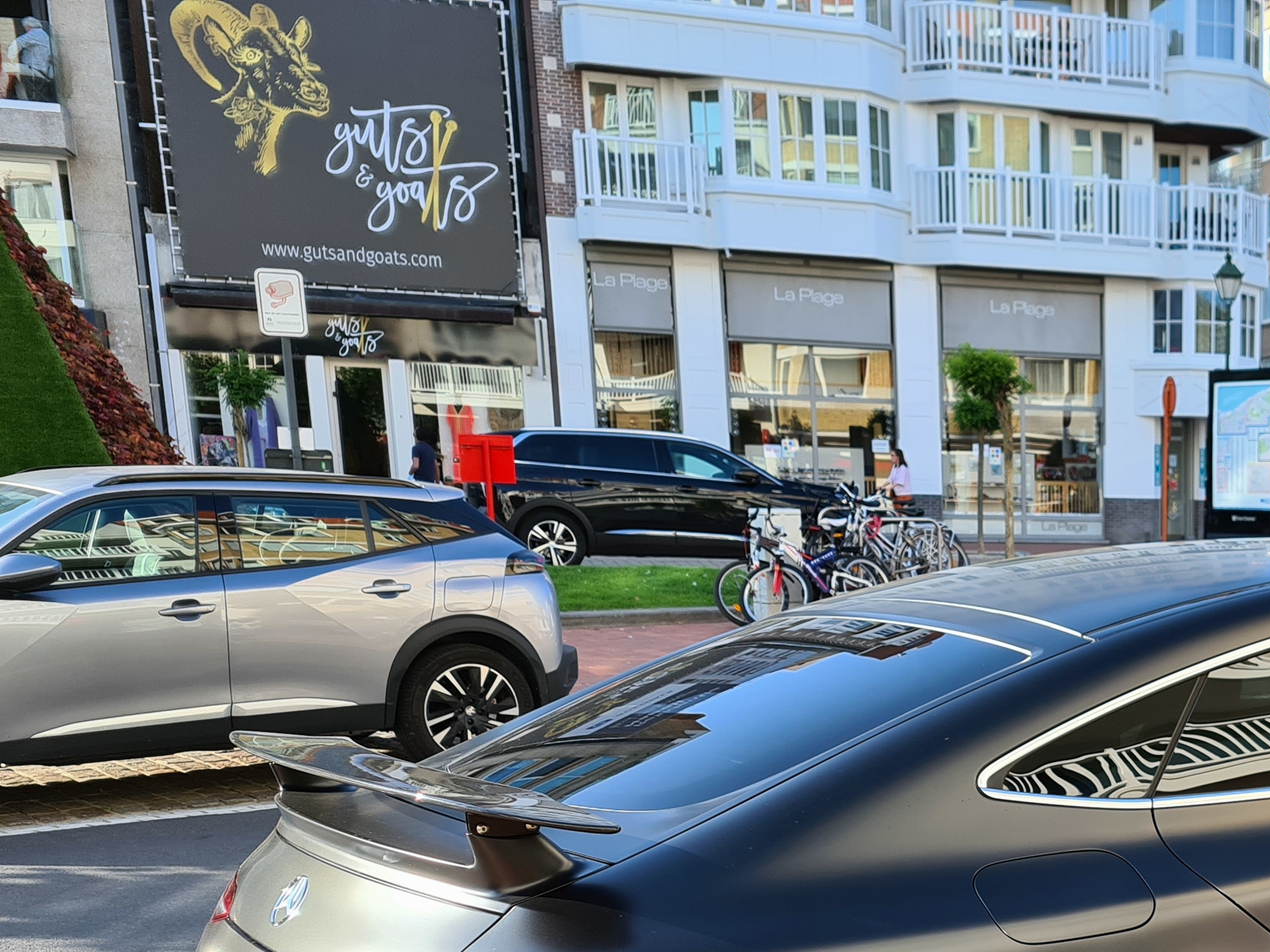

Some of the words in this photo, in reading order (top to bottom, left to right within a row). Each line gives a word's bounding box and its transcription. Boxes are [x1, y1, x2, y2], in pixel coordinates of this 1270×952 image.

[325, 100, 451, 175] guts
[355, 163, 374, 188] &
[367, 161, 499, 233] goats
[261, 242, 443, 269] www.gutsandgoats.com
[593, 271, 616, 288] La
[619, 272, 668, 293] Plage
[773, 286, 796, 302] La
[799, 287, 844, 307] Plage
[989, 299, 1011, 315] La
[1012, 300, 1056, 319] Plage
[325, 314, 362, 338] guts
[338, 330, 385, 357] goats
[1041, 521, 1056, 532] La
[1058, 521, 1088, 534] Plage
